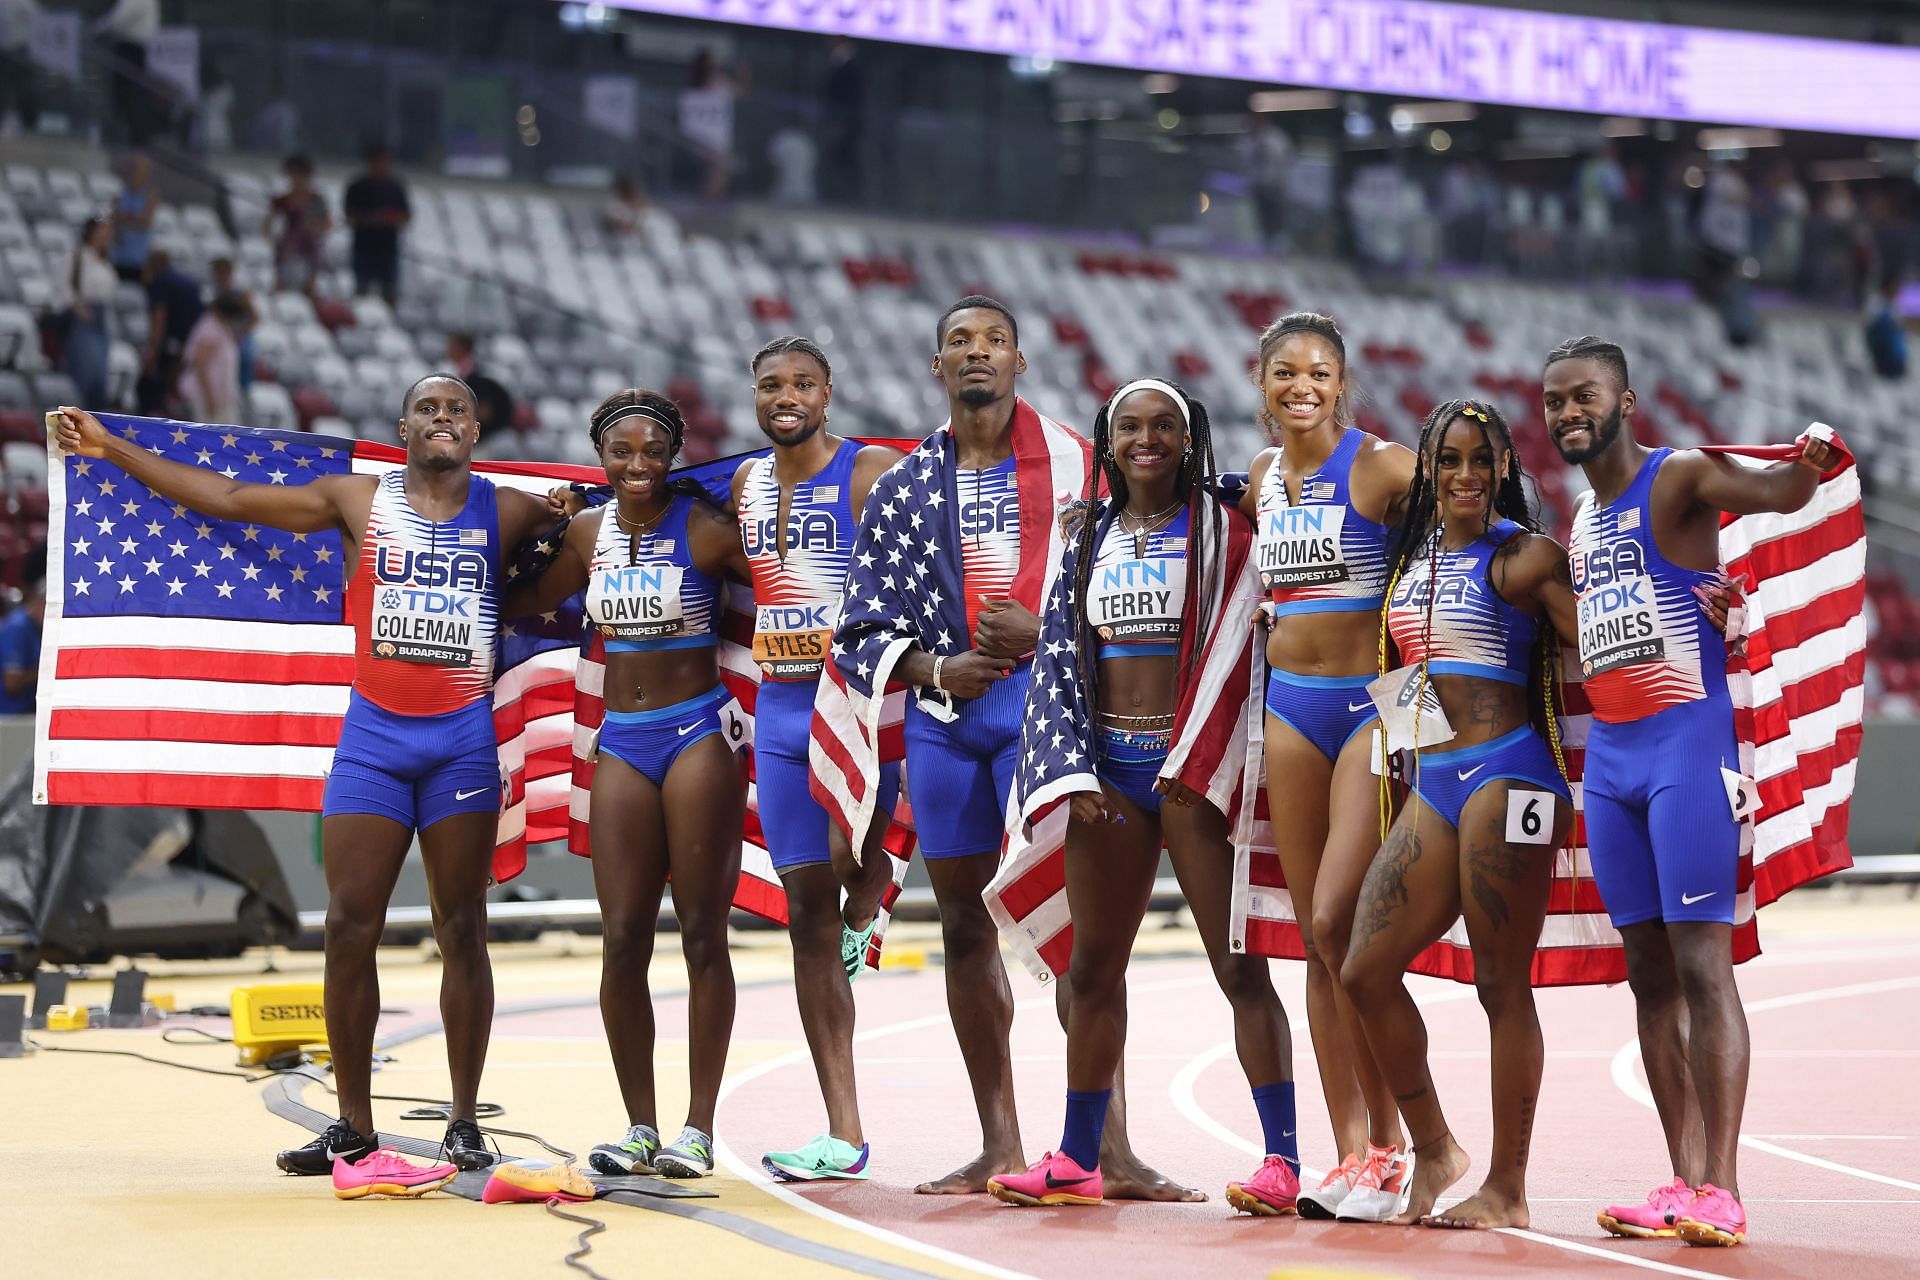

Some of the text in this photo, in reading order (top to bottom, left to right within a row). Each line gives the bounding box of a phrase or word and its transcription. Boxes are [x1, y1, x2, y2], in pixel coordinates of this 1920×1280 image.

[1119, 0, 1254, 66] SAFE
[1277, 0, 1522, 95] JOURNEY
[1537, 22, 1690, 111] HOME
[743, 513, 836, 557] USA
[1270, 508, 1324, 537] NTN
[1260, 538, 1336, 568] THOMAS
[1571, 539, 1646, 595] USA
[377, 546, 486, 593] USA
[604, 568, 662, 594] NTN
[1103, 560, 1167, 591] NTN
[1273, 569, 1341, 583] BUDAPEST 23
[402, 590, 470, 617] TDK
[1099, 591, 1171, 620] TERRY
[1391, 576, 1468, 609] USA
[1589, 581, 1646, 618] TDK
[601, 596, 663, 621] DAVIS
[768, 606, 829, 629] TDK
[377, 615, 471, 645] COLEMAN
[617, 624, 678, 636] BUDAPEST 23
[1115, 624, 1180, 635] BUDAPEST 23
[1582, 611, 1653, 657] CARNES
[399, 647, 466, 662] BUDAPEST 23
[764, 634, 822, 657] LYLES
[1593, 645, 1657, 669] BUDAPEST 23
[776, 662, 823, 673] BUDAPEST
[729, 710, 744, 741] 6
[1521, 798, 1542, 836] 6
[259, 1005, 326, 1021] SEIK
